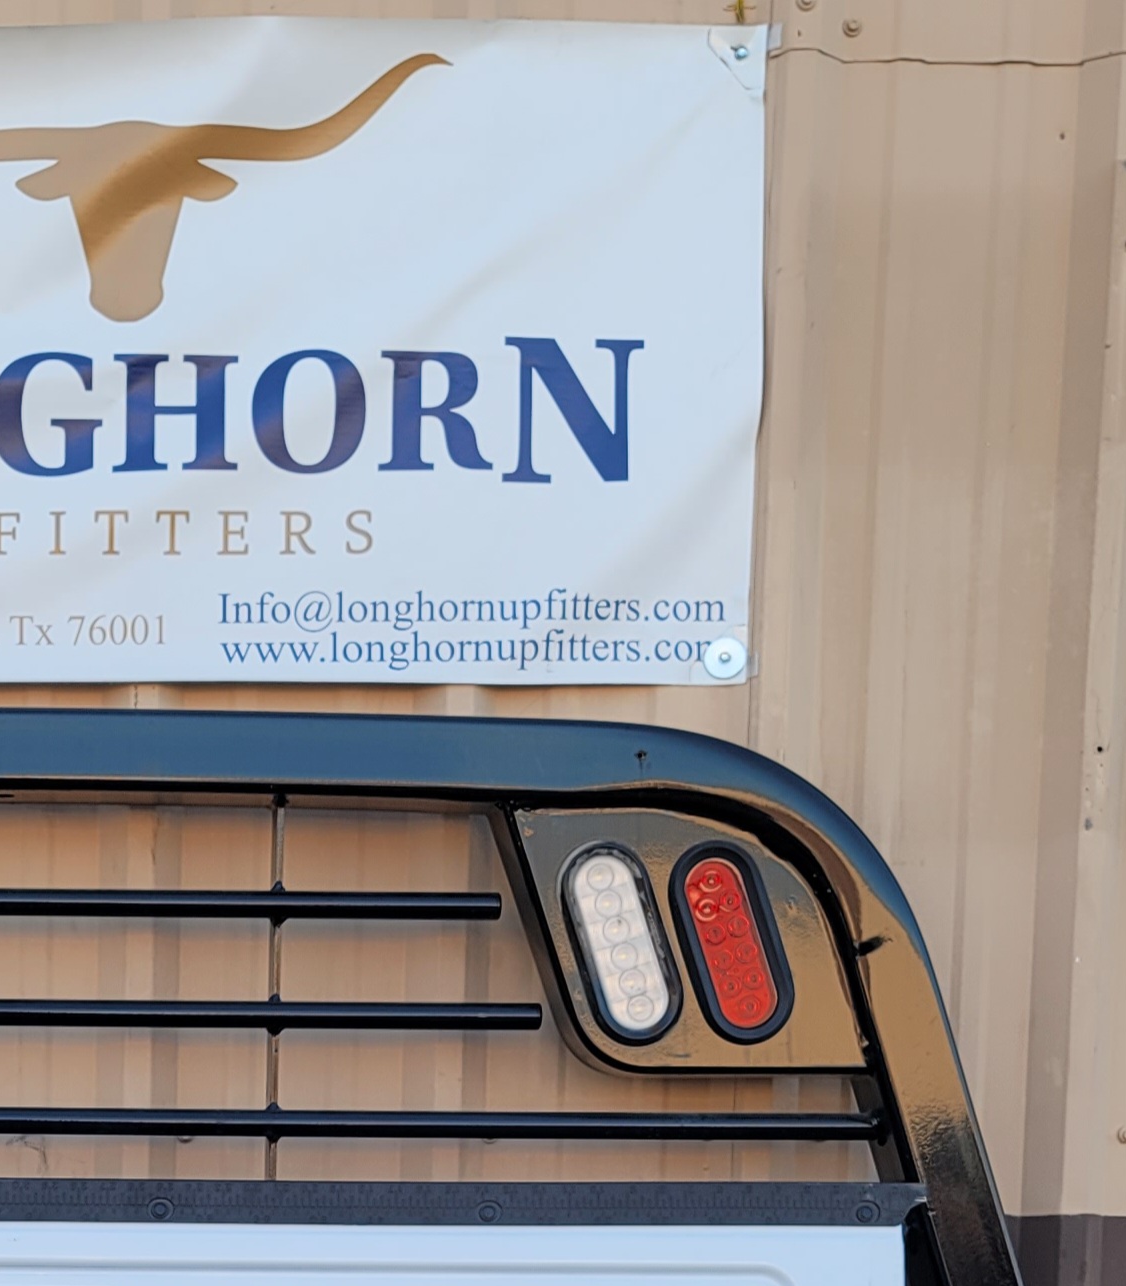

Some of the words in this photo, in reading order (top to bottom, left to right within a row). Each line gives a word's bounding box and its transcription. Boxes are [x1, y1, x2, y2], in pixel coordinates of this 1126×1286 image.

[219, 588, 726, 633] Info@longhornupfitters.com
[10, 616, 54, 646] Tx
[67, 615, 164, 646] 76001
